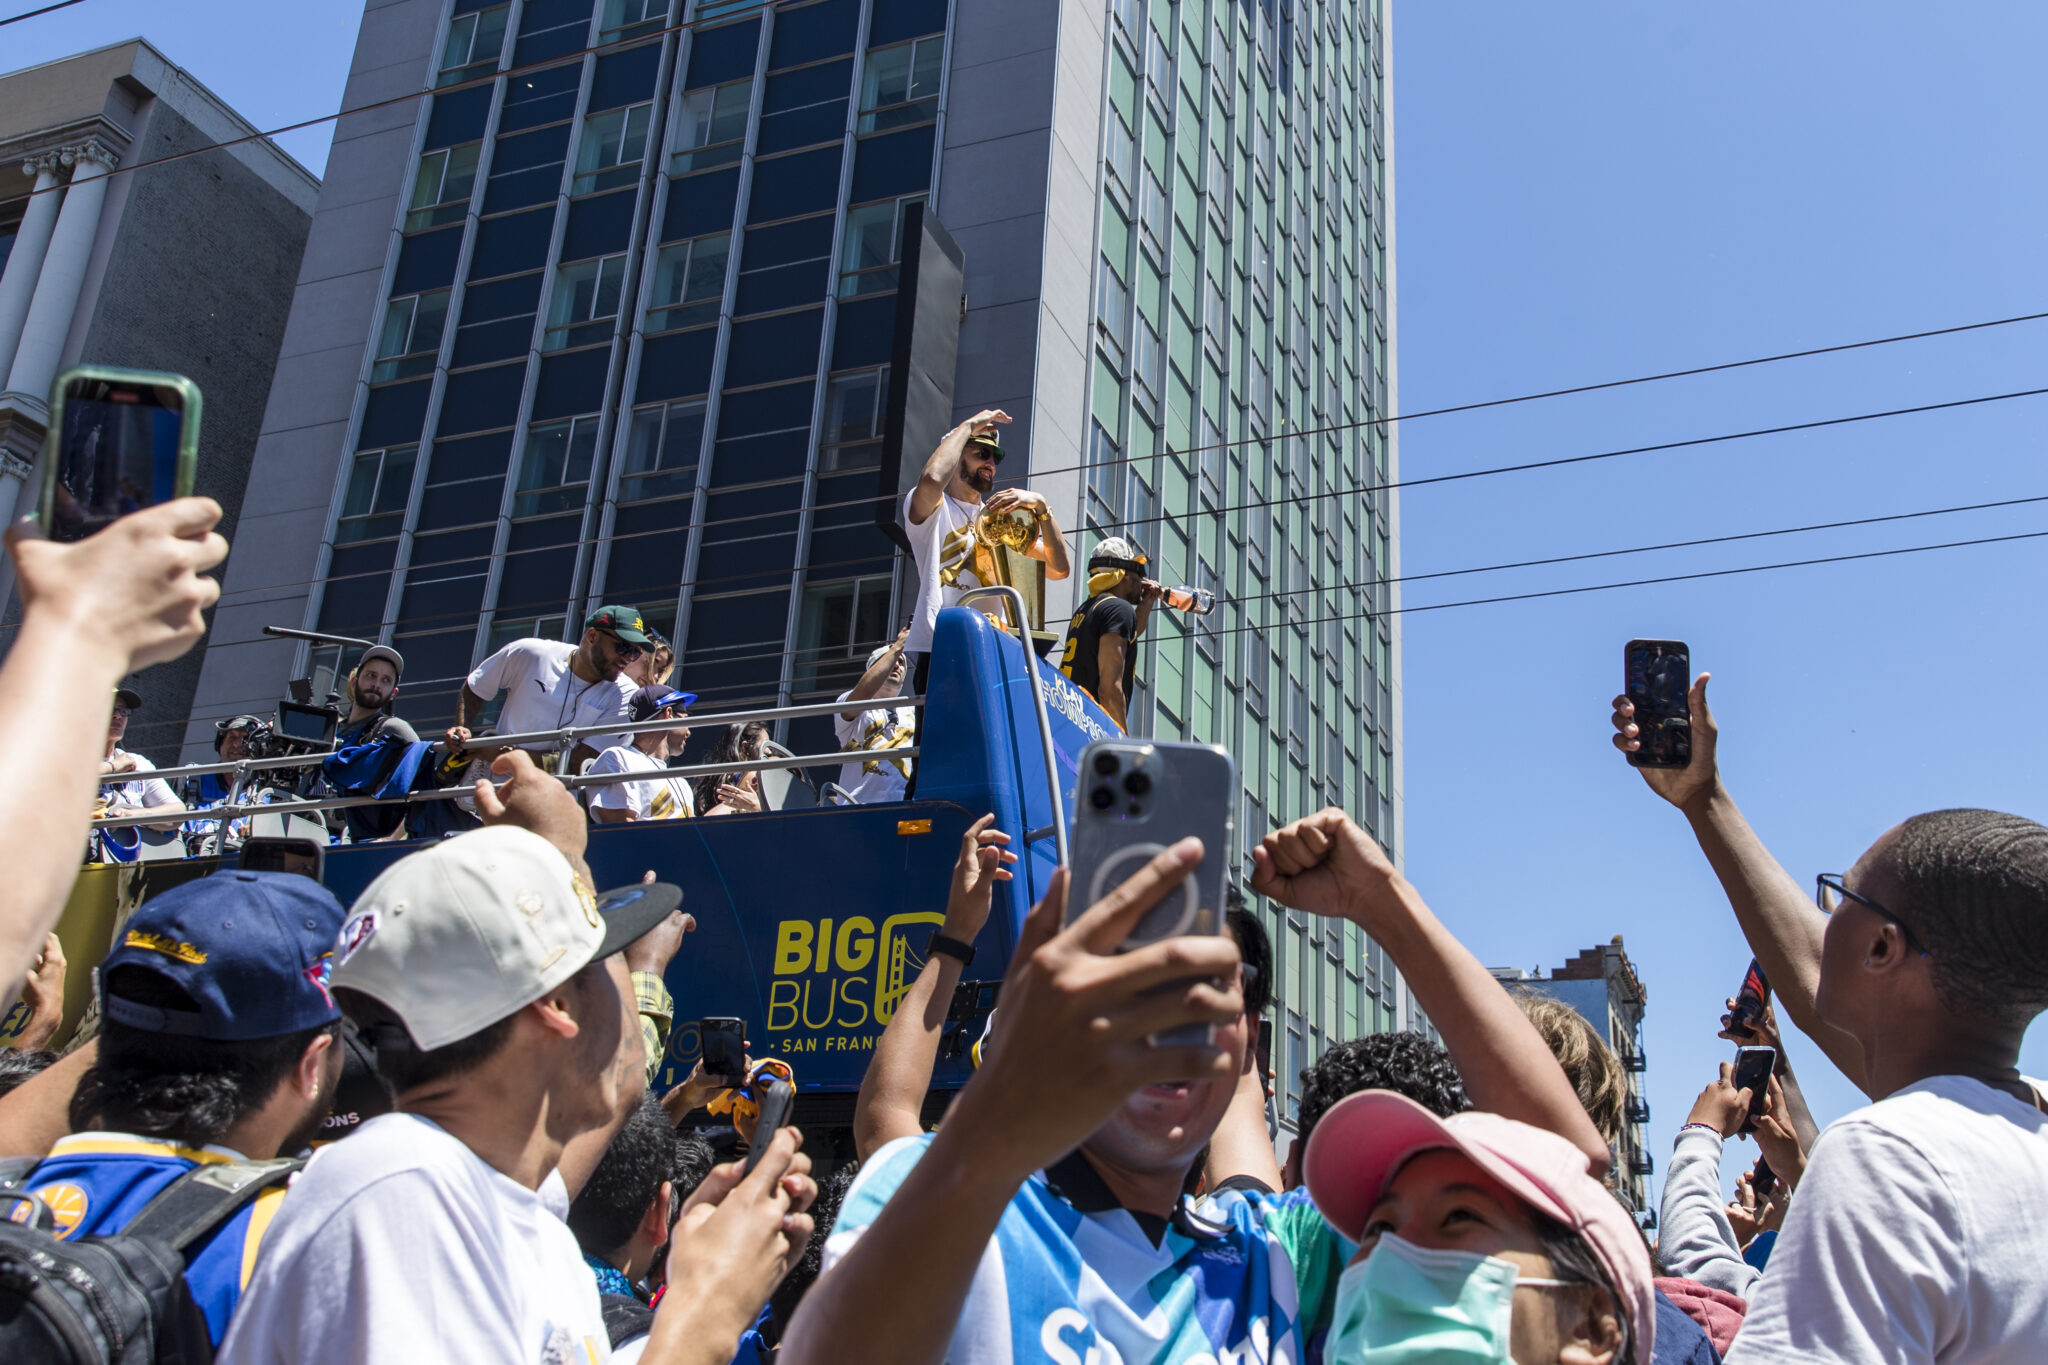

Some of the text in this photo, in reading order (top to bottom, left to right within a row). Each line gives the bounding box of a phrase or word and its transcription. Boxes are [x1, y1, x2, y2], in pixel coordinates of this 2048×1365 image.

[1039, 676, 1106, 741] HOMPSO
[773, 915, 875, 975] BIG
[767, 976, 868, 1031] BUS
[782, 1038, 817, 1053] SAN
